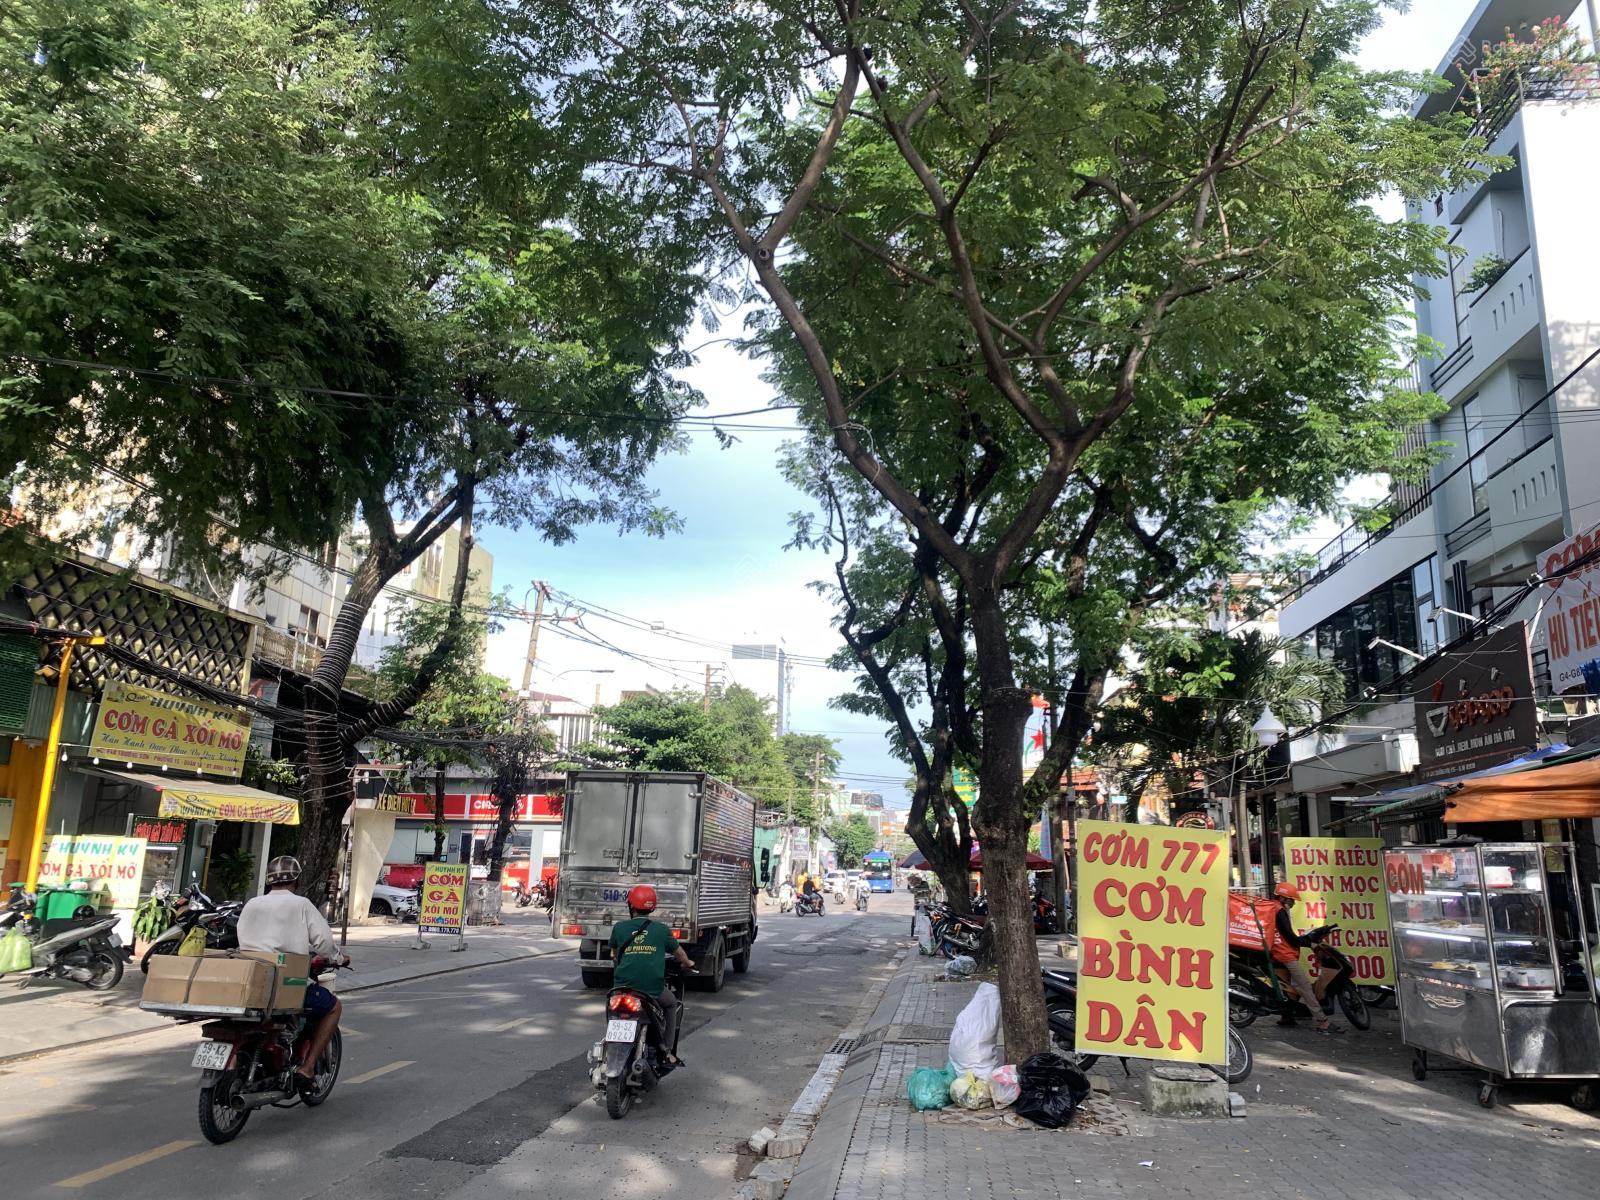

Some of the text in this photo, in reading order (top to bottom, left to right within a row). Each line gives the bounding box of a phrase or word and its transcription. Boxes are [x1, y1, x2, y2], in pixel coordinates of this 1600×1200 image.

[1548, 596, 1570, 661] HỦ
[104, 709, 244, 751] CƠM GÀ XỐI MỠ
[1083, 830, 1221, 874] CƠM 777
[1290, 844, 1379, 867] BÚN RIÊU
[427, 873, 464, 886] CƠM
[1296, 871, 1380, 897] BÚN MỌC
[1386, 857, 1425, 895] CƠM
[428, 888, 460, 903] GÀ
[1093, 875, 1206, 926] CƠM
[1305, 897, 1327, 919] MÌ
[1341, 902, 1376, 920] NUI
[1345, 929, 1389, 948] CANH
[1080, 929, 1214, 990] BÌNH
[1084, 993, 1207, 1053] DÂN
